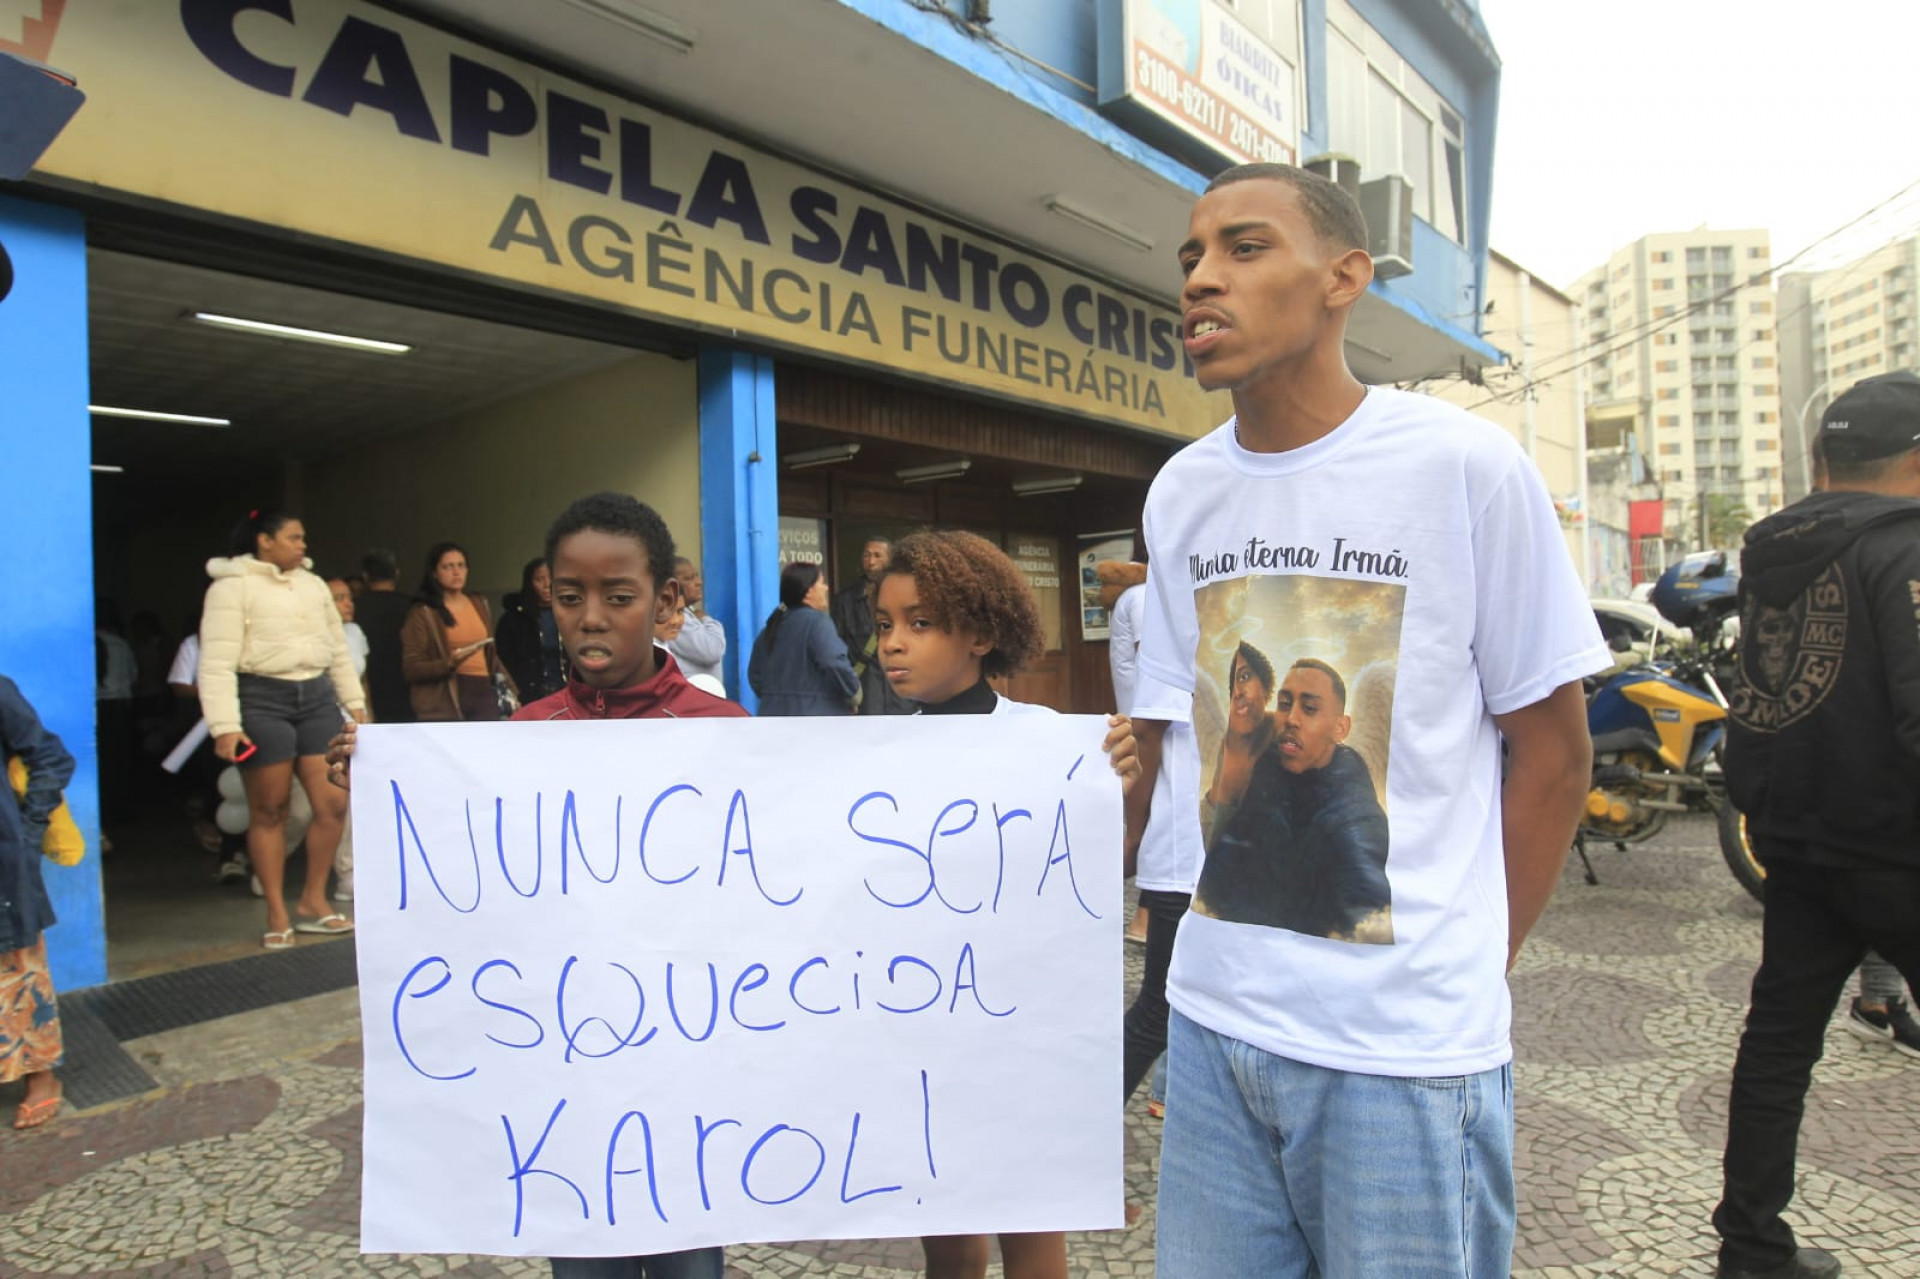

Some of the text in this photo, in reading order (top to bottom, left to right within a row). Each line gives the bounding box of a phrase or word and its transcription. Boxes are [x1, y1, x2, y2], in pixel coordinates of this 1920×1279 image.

[180, 0, 1197, 378] CAPELA SANTO CRIST
[488, 194, 1166, 418] AGÊNCIA FUNERÁRIA
[778, 529, 819, 548] VIÇOS
[790, 550, 823, 565] TODO
[1329, 537, 1409, 578] Irmã.
[1805, 622, 1843, 645] MC
[391, 780, 804, 913] NUNCA
